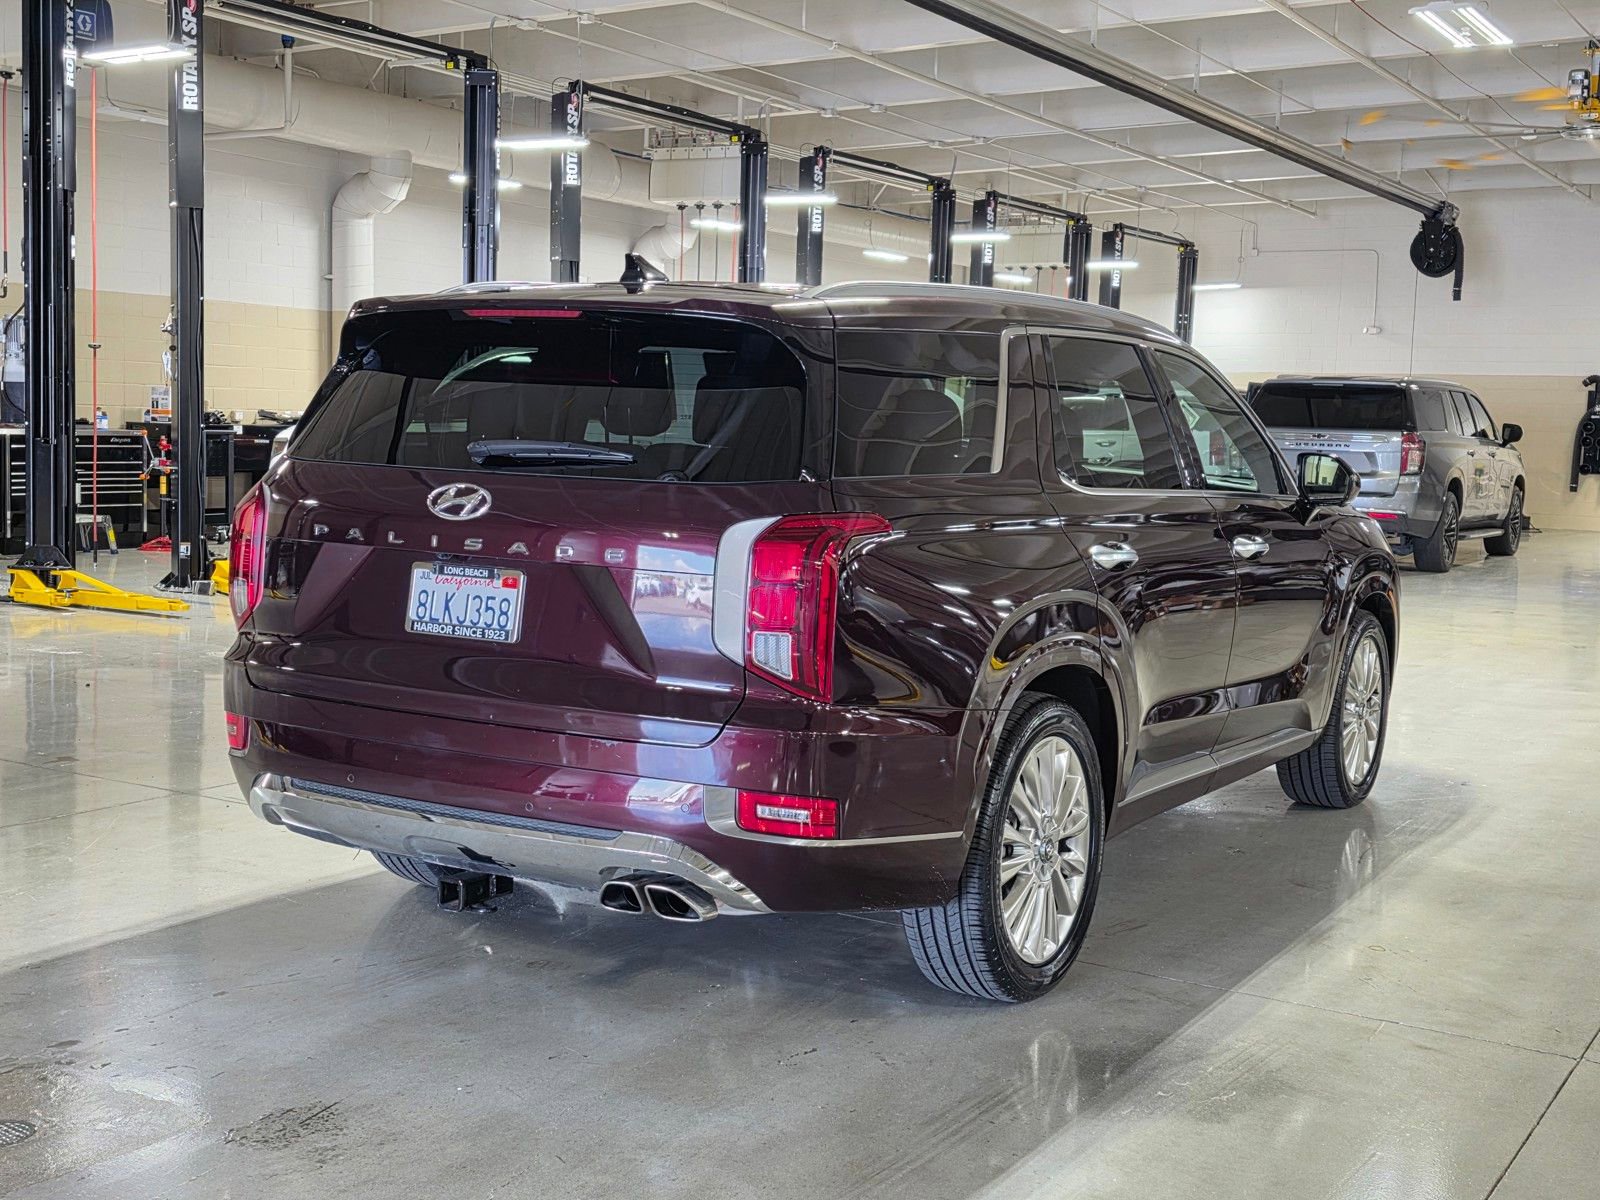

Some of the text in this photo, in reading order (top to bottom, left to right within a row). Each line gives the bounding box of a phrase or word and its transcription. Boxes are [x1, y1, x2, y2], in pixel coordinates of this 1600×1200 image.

[66, 6, 74, 87] ROARY
[566, 126, 578, 185] ROTY
[811, 183, 823, 232] ROTY
[984, 221, 994, 264] ROTY
[313, 523, 626, 563] PALISADE
[444, 566, 489, 578] LONG BEACH
[416, 589, 511, 629] 8LKJ358
[413, 621, 506, 640] HARBOR SINCE 1923
